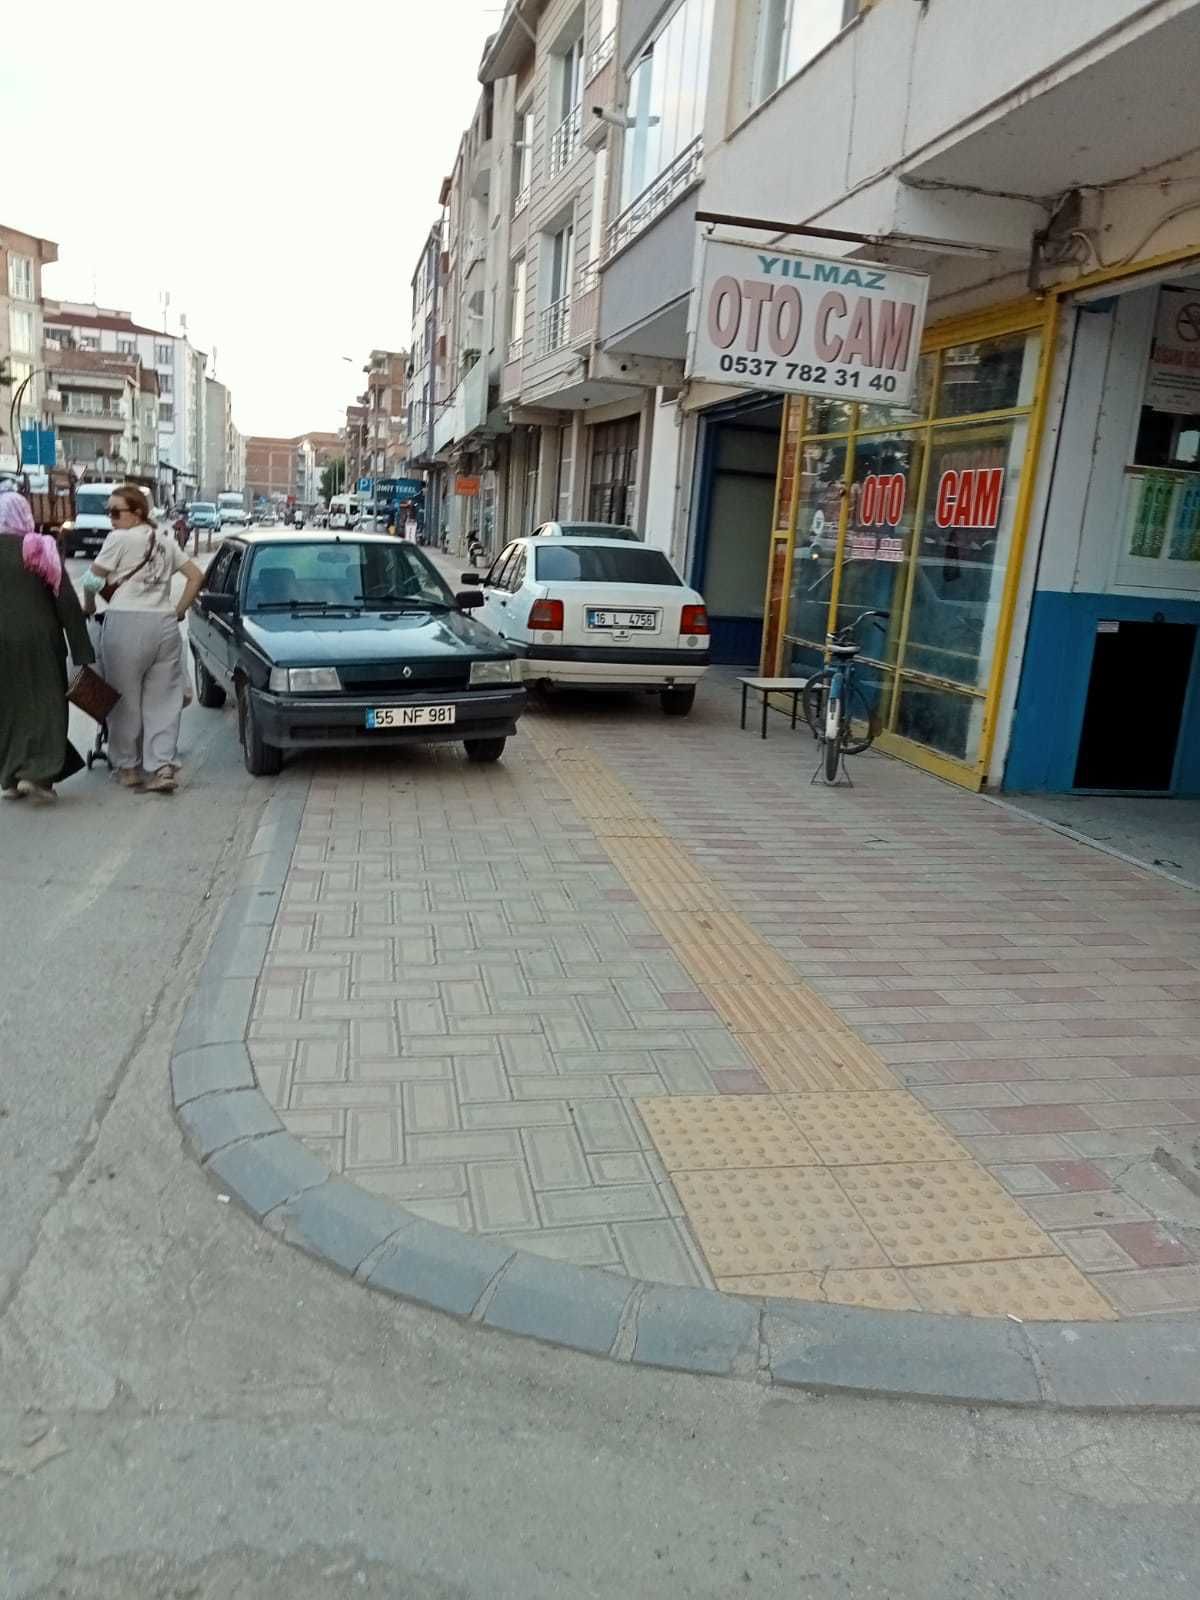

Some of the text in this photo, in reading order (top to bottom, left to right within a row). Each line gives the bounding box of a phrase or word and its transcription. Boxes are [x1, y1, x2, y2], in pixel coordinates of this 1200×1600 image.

[757, 255, 887, 291] YILMAZ
[707, 275, 916, 373] OTO CAM
[719, 354, 897, 393] 0537 782 31 40
[860, 467, 1004, 529] OTO CAM
[613, 613, 619, 625] L
[375, 707, 452, 725] 55 NF 981
